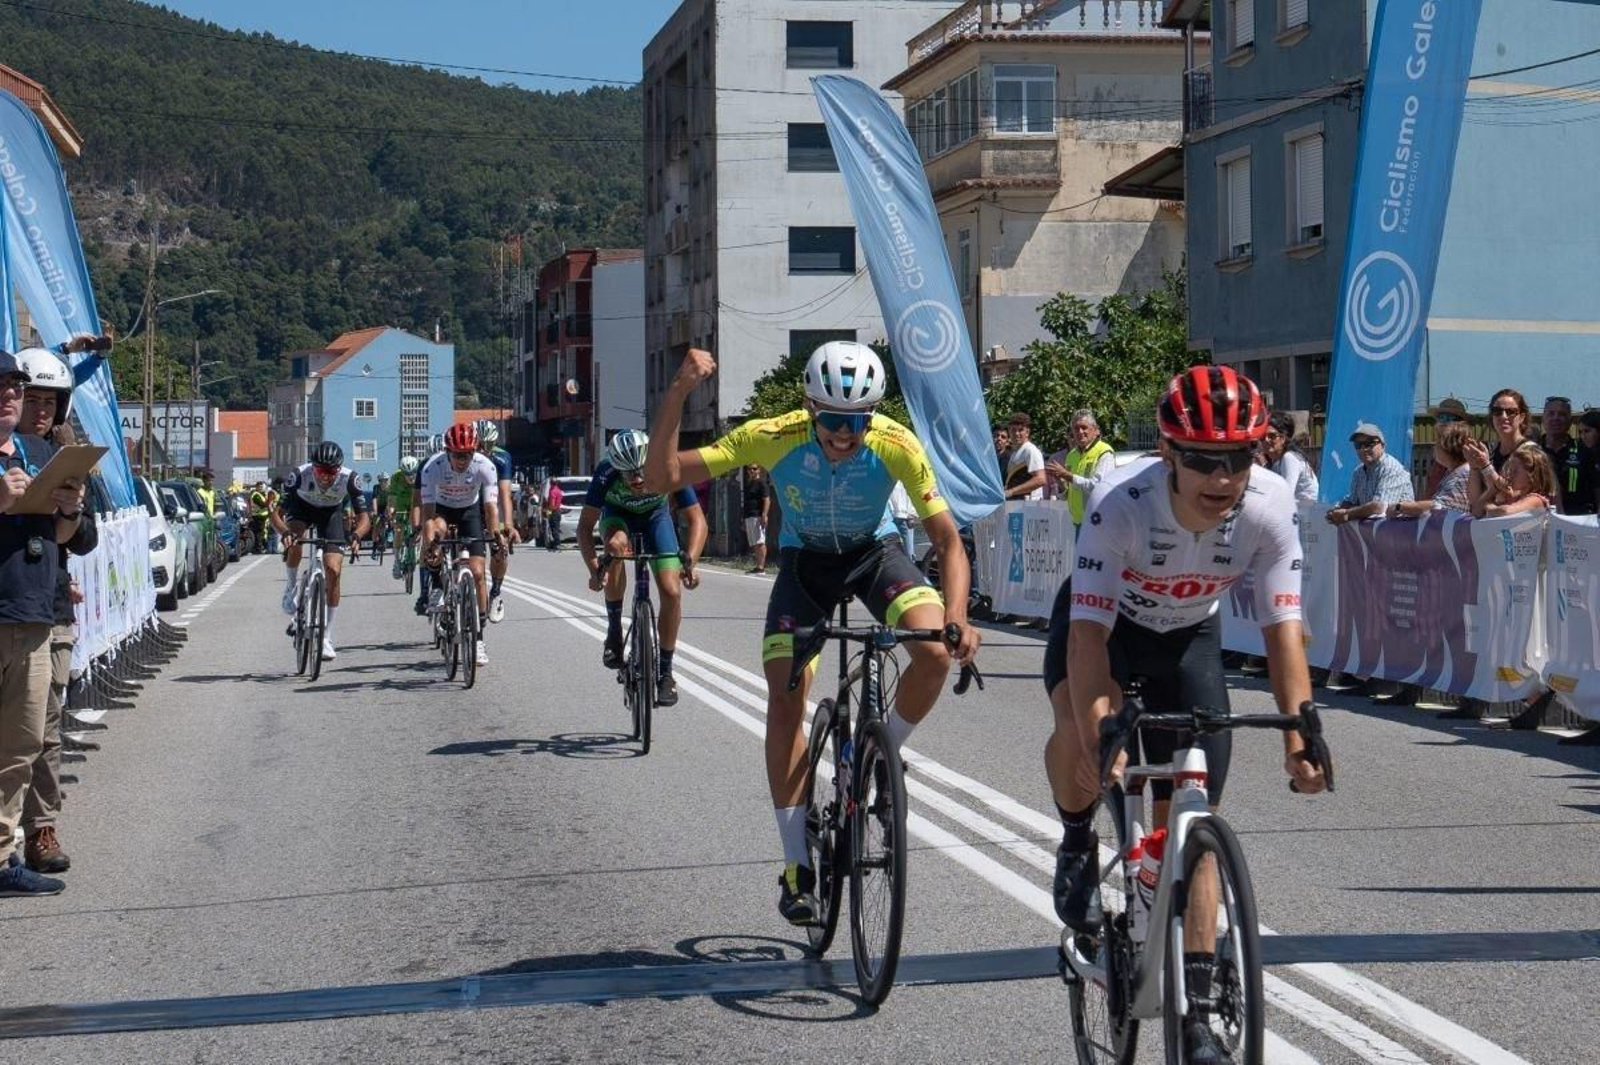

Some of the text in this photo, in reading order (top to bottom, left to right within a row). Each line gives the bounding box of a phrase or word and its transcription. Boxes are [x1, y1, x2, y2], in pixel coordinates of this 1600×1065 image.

[1380, 0, 1440, 232] Ciclismo Gale
[1399, 151, 1421, 232] Federación
[1078, 556, 1103, 571] BH
[1290, 559, 1302, 571] B
